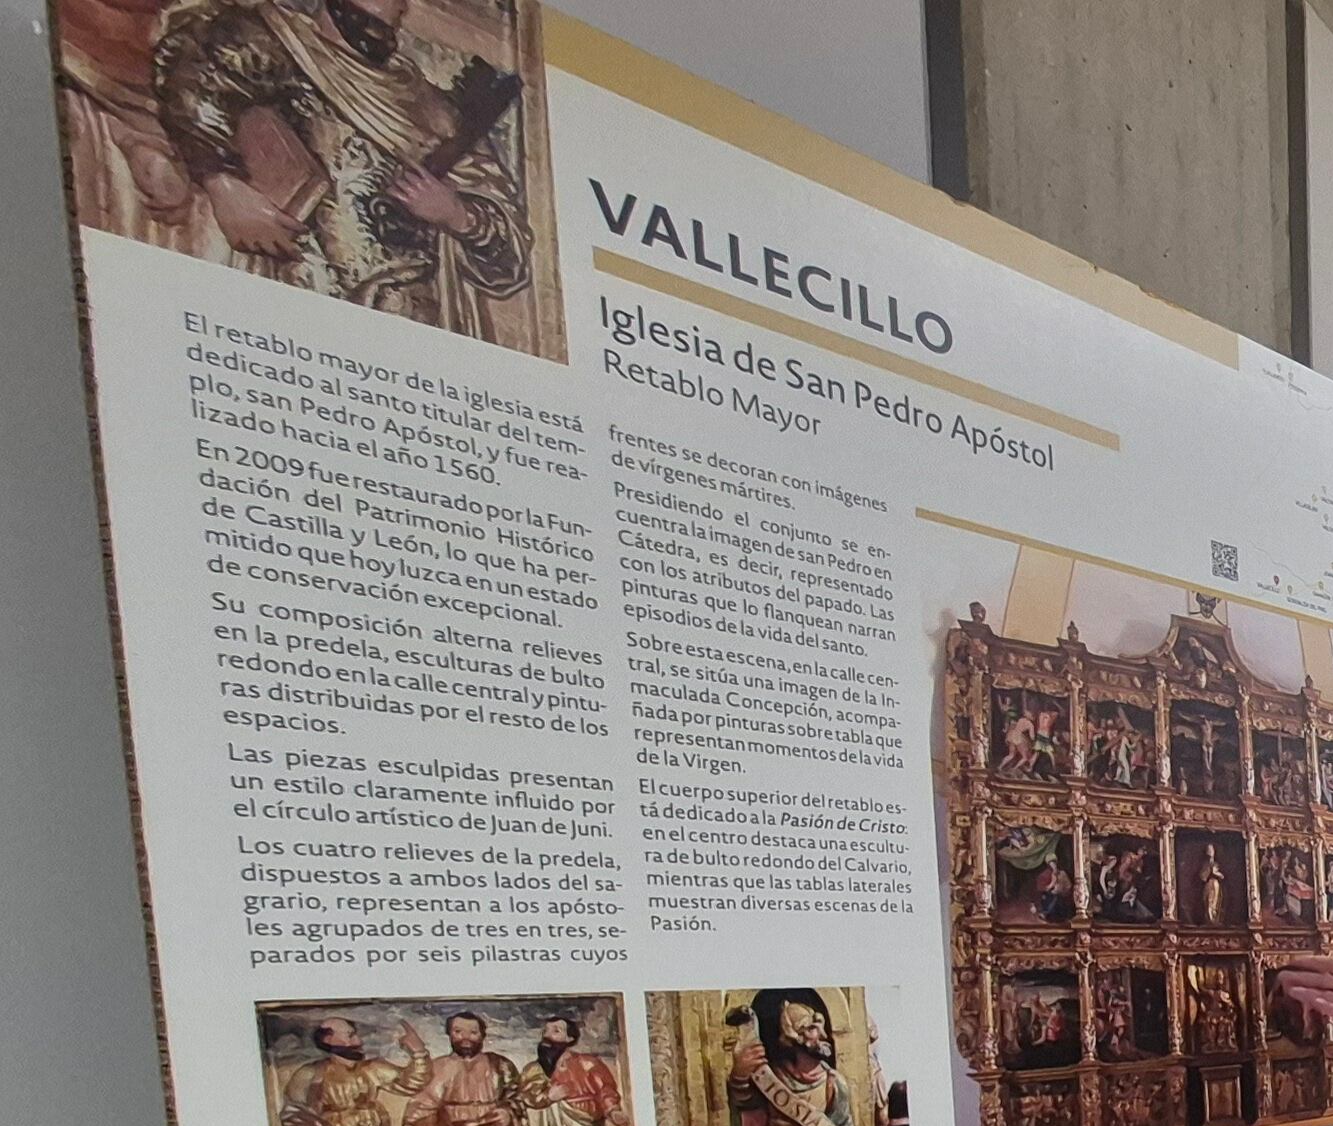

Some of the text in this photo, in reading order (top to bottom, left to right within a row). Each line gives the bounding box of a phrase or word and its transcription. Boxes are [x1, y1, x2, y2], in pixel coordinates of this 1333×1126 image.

[588, 178, 953, 354] VALLECILLO
[183, 310, 584, 433] El retablo mayor de la iglesia está
[600, 296, 1054, 471] Iglesia de San Pedro Apóstol
[604, 349, 821, 436] Retablo Mayor
[188, 373, 588, 480] plo, san Pedro Apóstol, y fue rea-
[608, 423, 887, 512] frentes se decoran con imágenes
[199, 467, 593, 561] dación del Patrimonio Histórico
[201, 496, 597, 585] de Castilla y León, lo que ha per-
[210, 591, 602, 665] Su composición alterna relieves
[619, 556, 894, 621] con los atributos del papado. Las
[243, 891, 624, 918] grario, representan a los apósto-
[650, 914, 716, 931] Pasión.
[250, 944, 628, 968] parados por seis pilastras cuyos
